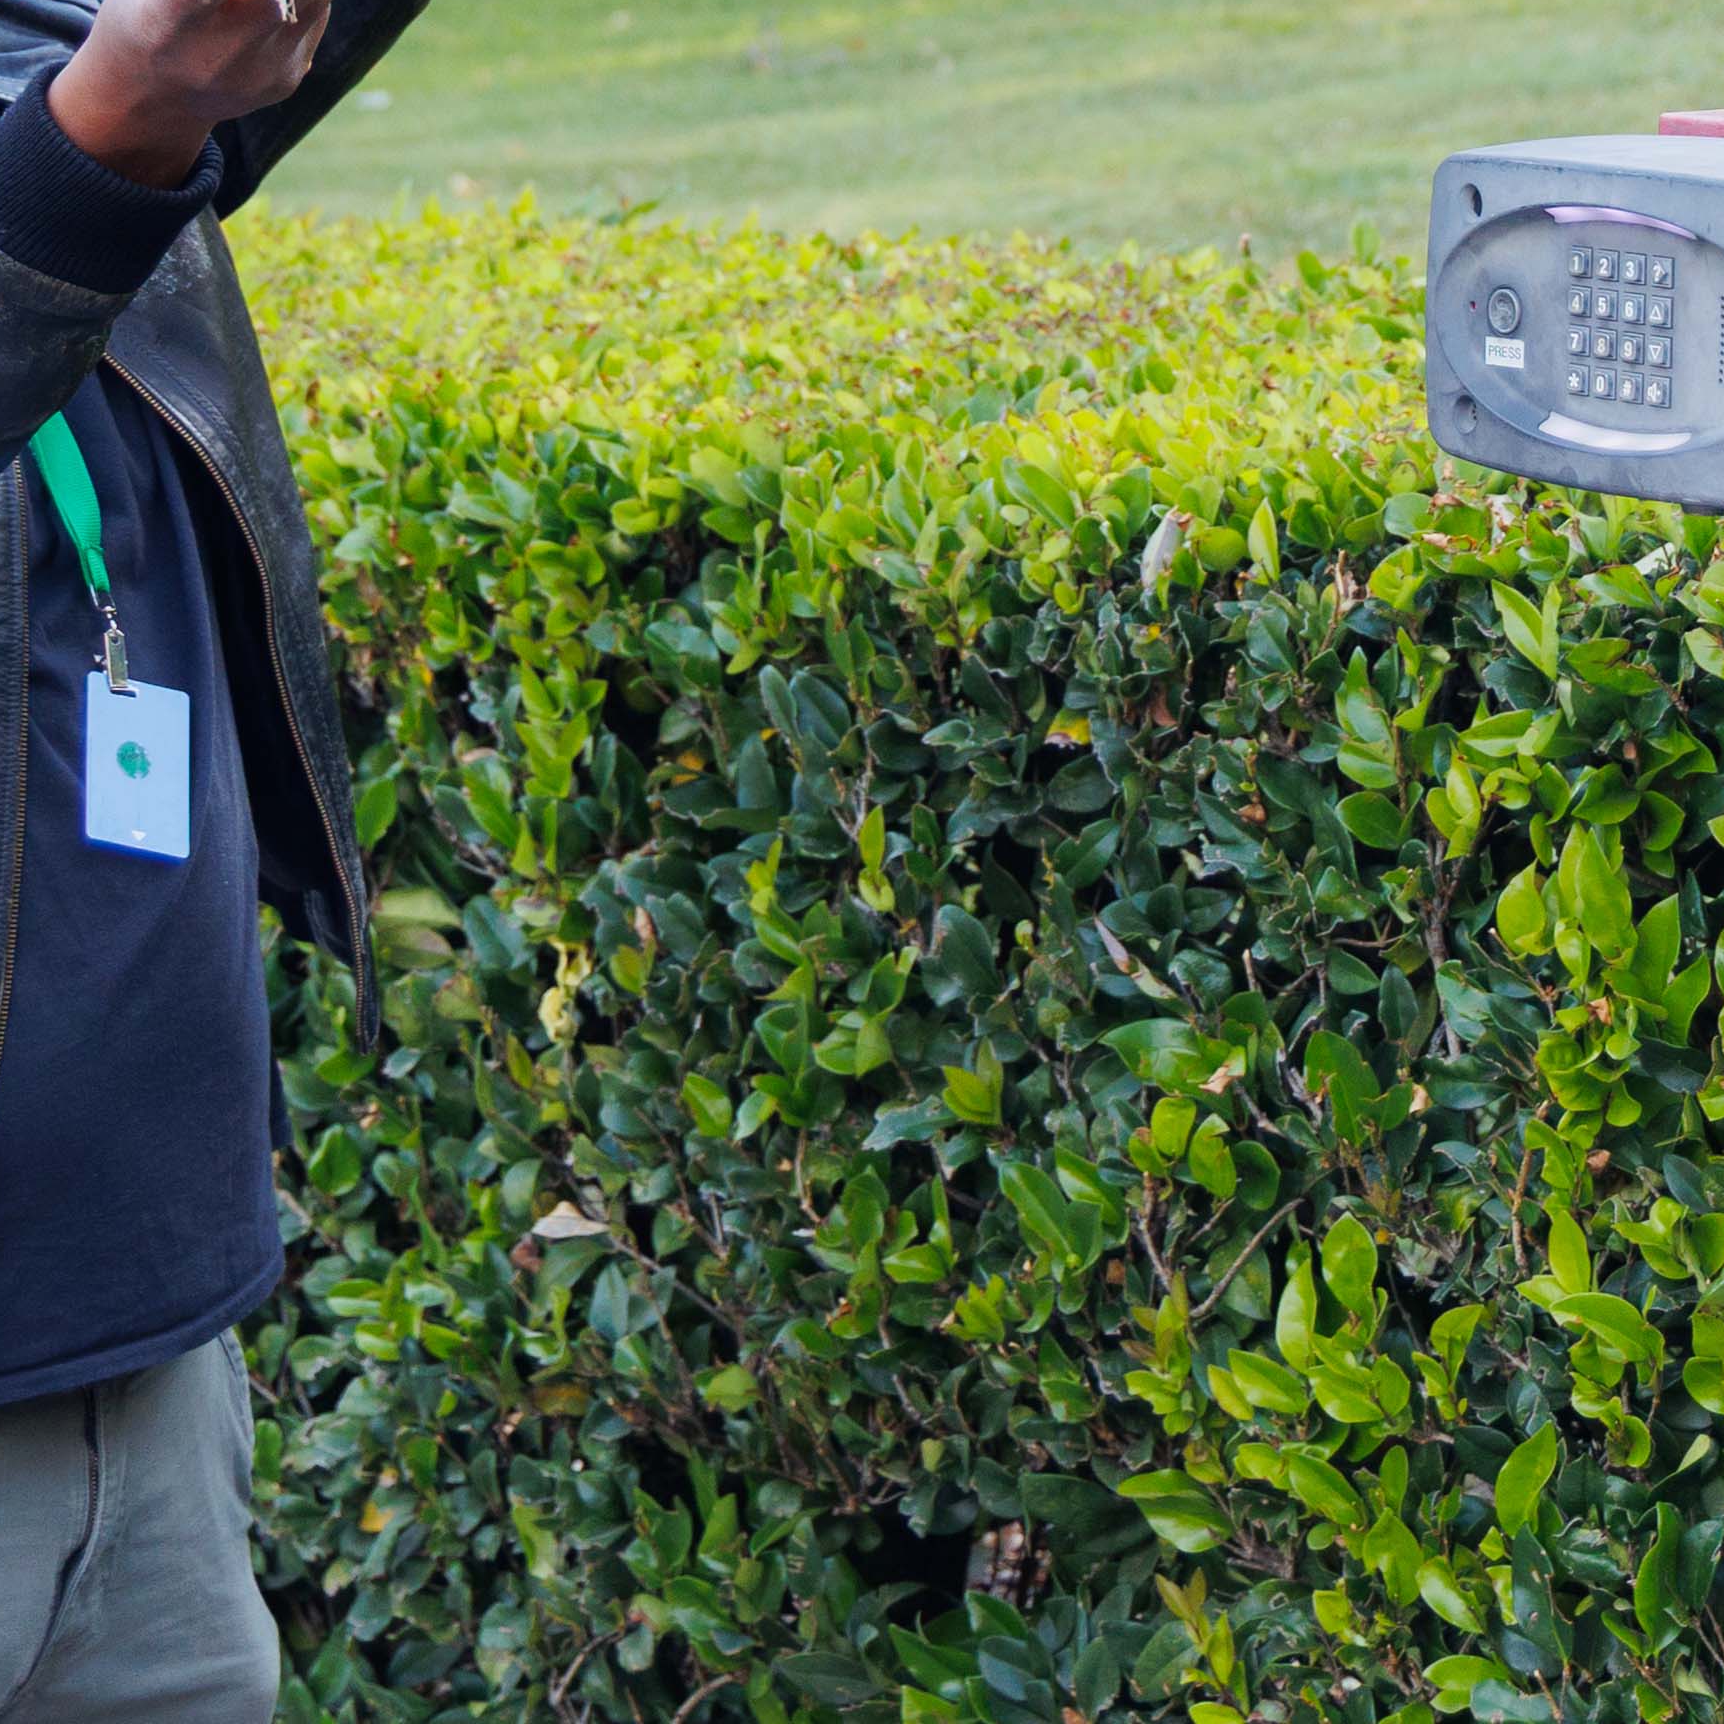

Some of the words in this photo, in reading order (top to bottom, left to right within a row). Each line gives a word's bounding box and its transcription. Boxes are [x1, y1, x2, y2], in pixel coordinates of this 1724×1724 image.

[1599, 258, 1608, 274] 2
[1625, 261, 1634, 277] 3
[1598, 297, 1607, 313] 5
[1624, 301, 1634, 317] 6
[1488, 345, 1522, 359] PRESS
[1596, 337, 1606, 353] 8
[1624, 341, 1633, 357] 9
